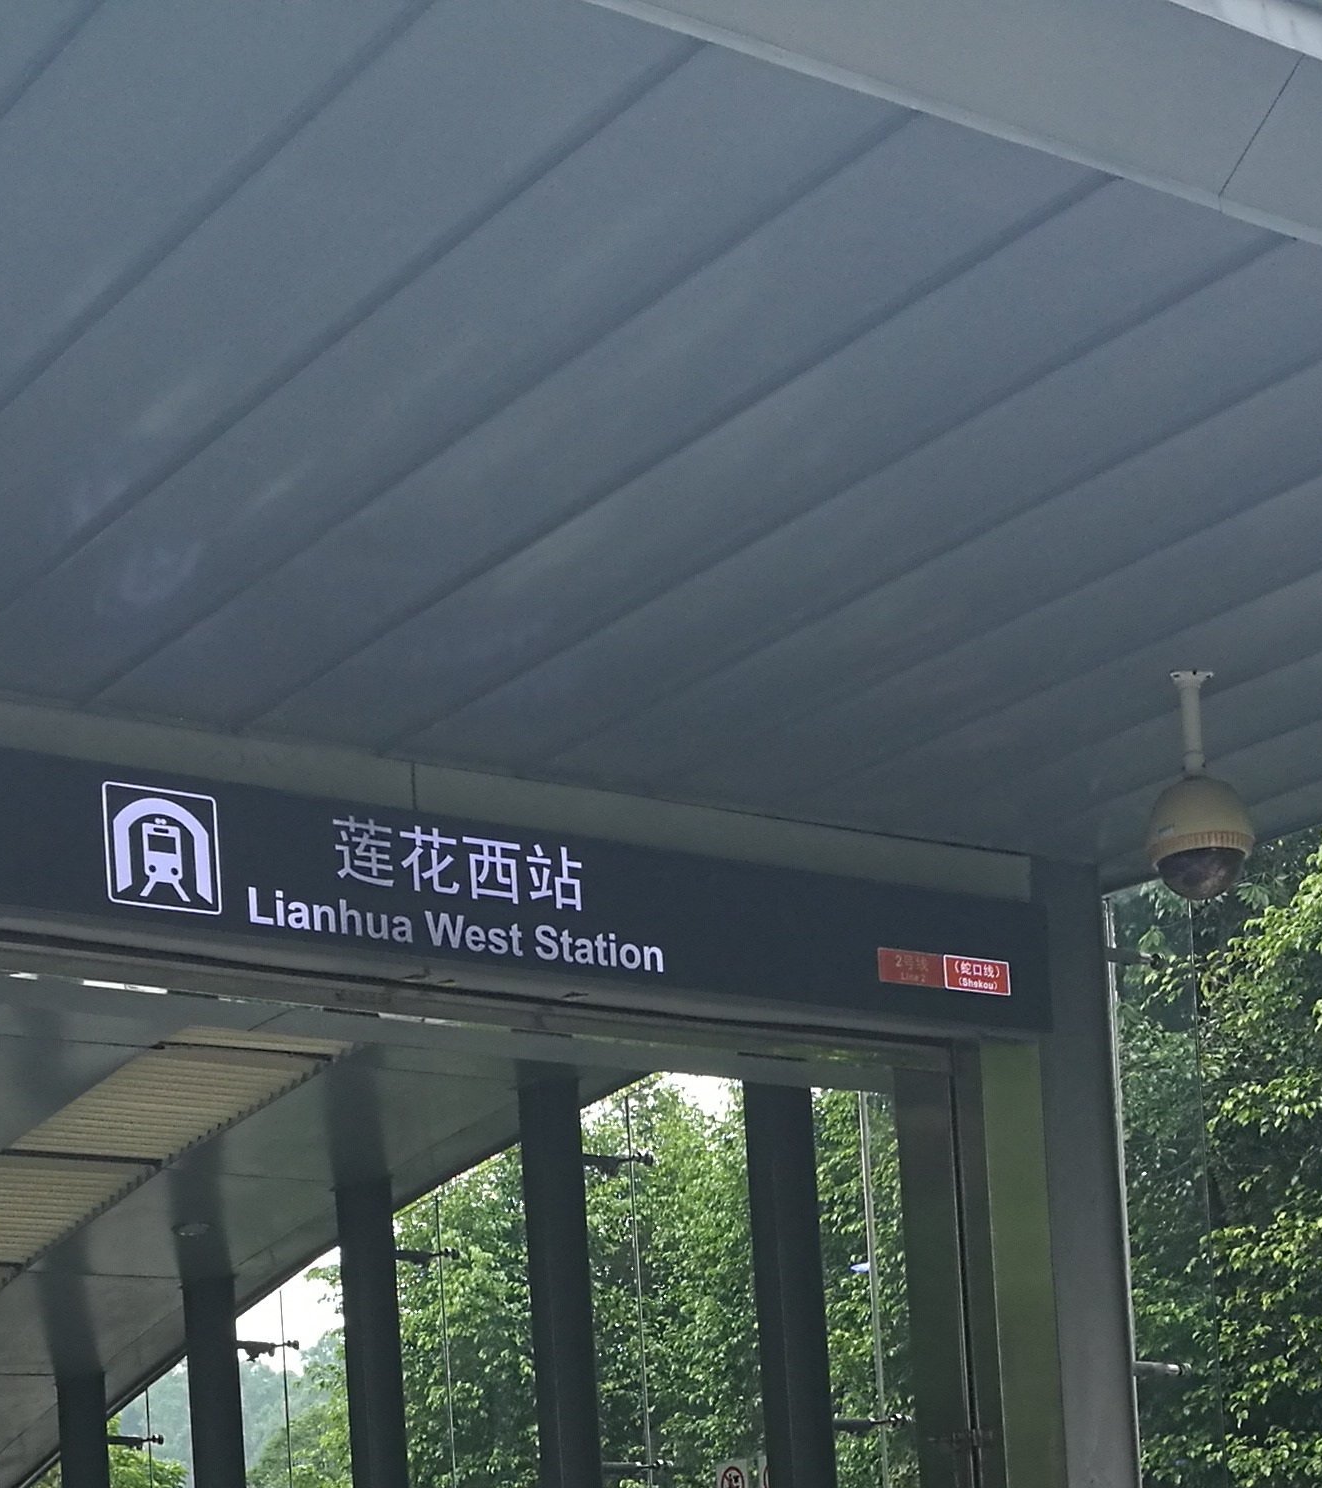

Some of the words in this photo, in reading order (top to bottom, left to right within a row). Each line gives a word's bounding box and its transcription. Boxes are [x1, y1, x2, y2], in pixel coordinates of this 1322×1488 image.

[332, 815, 583, 911] 莲花西站
[247, 886, 414, 944] Lianhua
[424, 910, 524, 957] West
[534, 924, 665, 973] Station
[958, 976, 998, 991] (Shekou)
